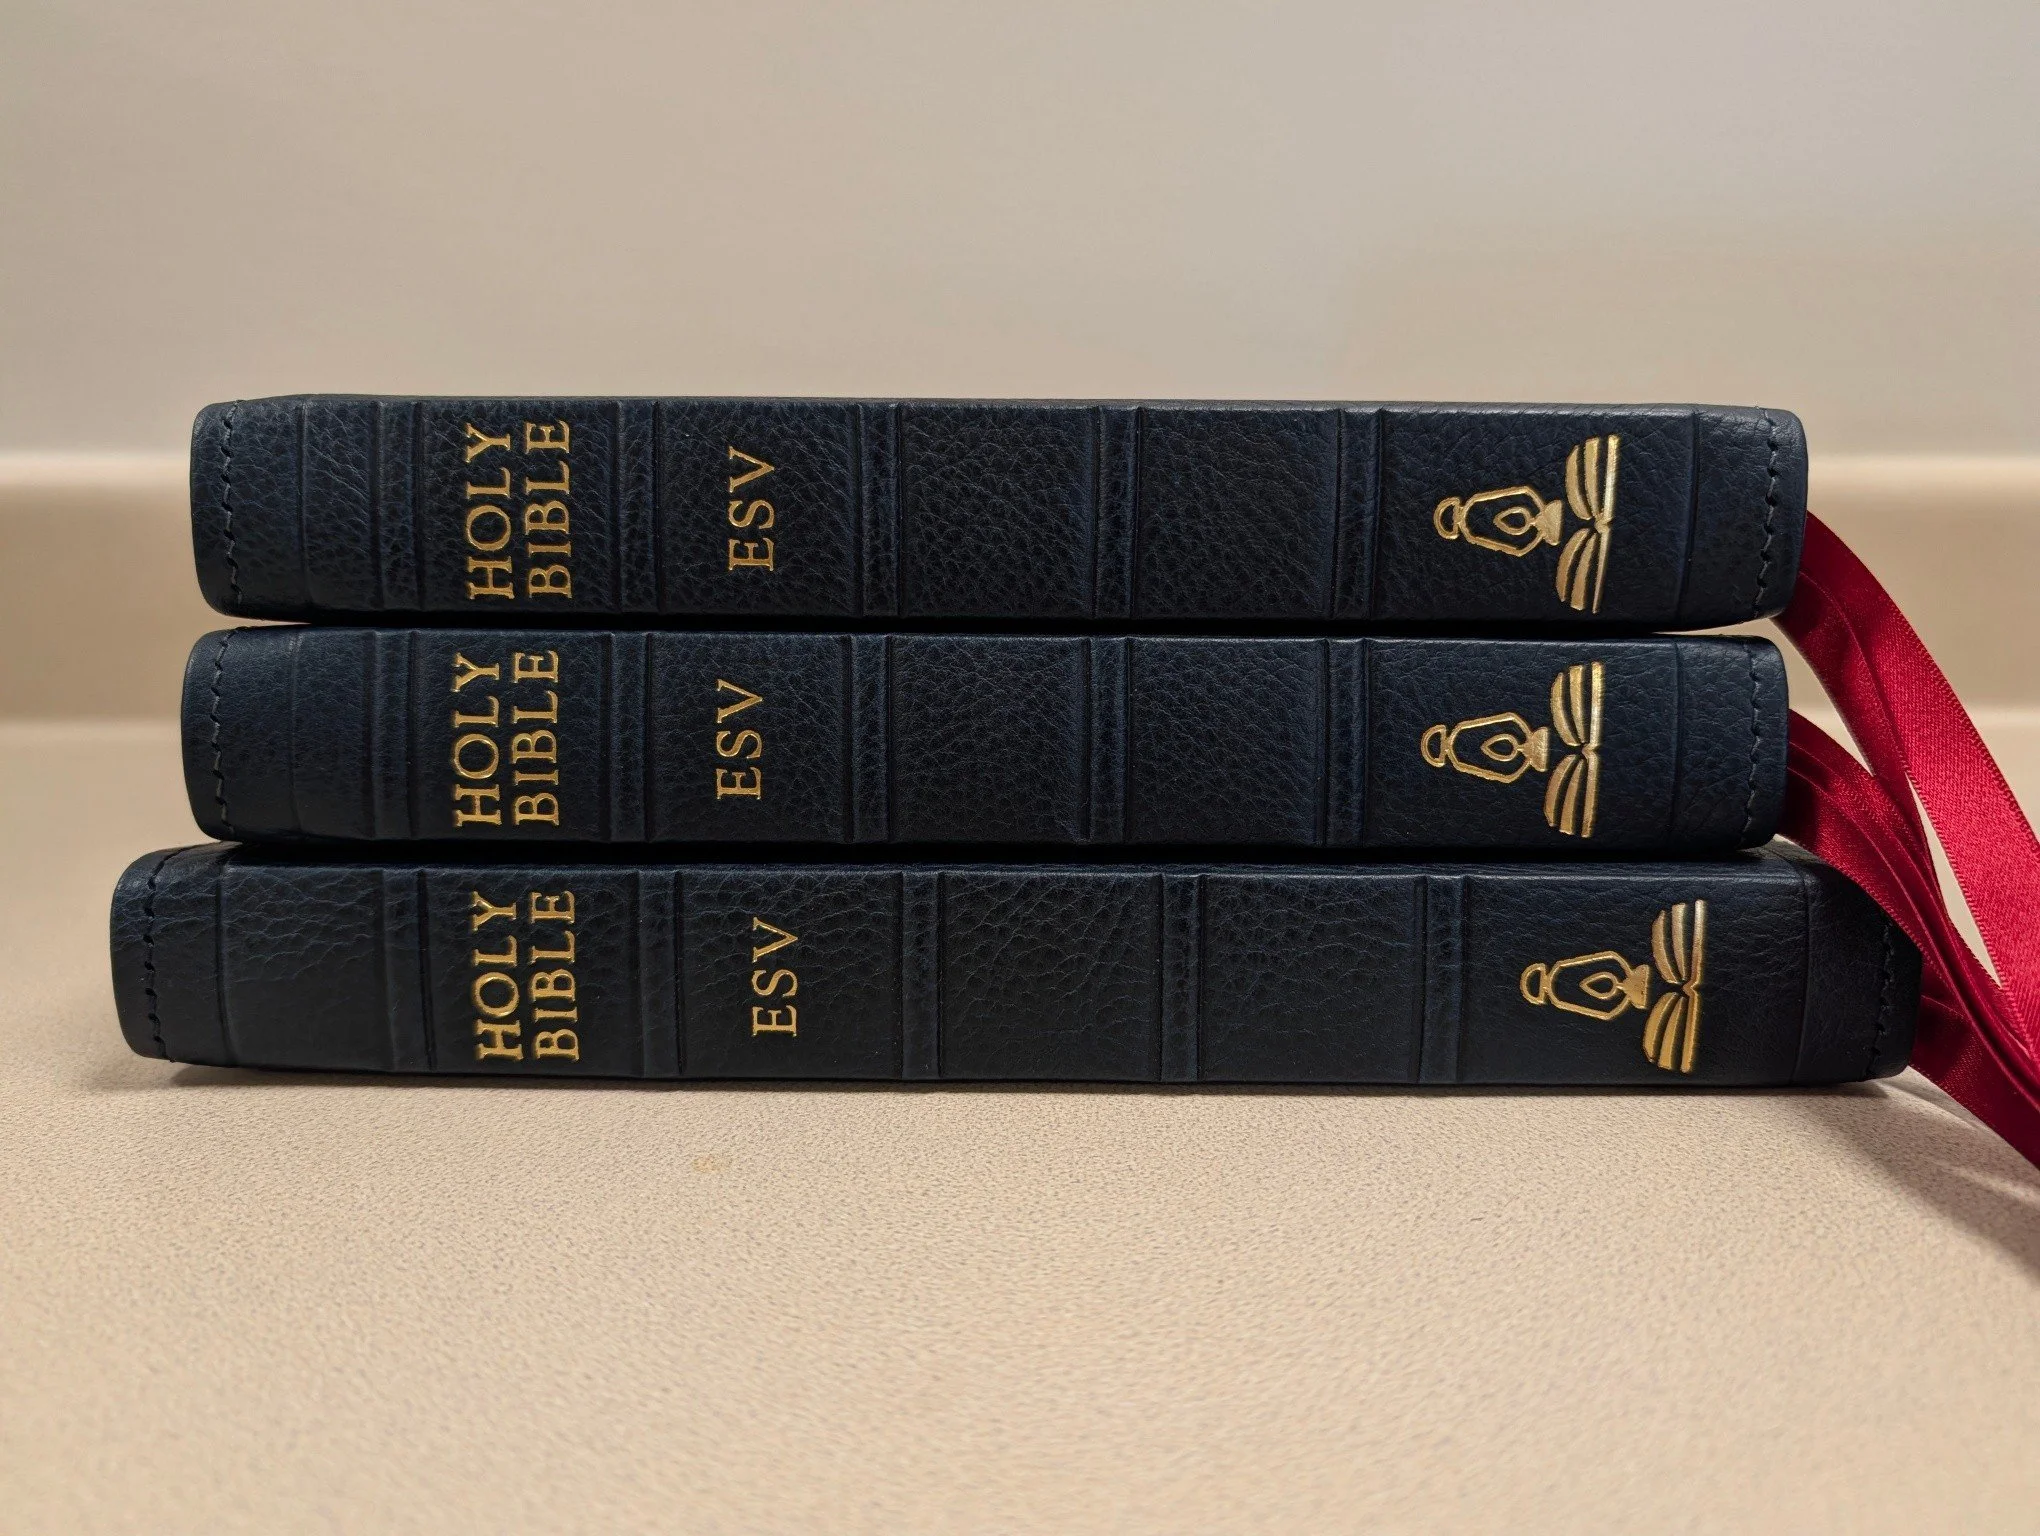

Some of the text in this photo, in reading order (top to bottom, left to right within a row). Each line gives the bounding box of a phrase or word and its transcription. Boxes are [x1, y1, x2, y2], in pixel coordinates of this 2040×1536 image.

[465, 423, 514, 600] HOLY
[524, 420, 572, 600] BIBLE
[727, 447, 775, 572] ESV
[452, 653, 502, 828] HOLY
[510, 650, 559, 827] BIBLE
[715, 679, 763, 800] ESV
[472, 891, 525, 1062] HOLY
[529, 891, 580, 1062] BIBLE
[751, 918, 799, 1037] ESV
